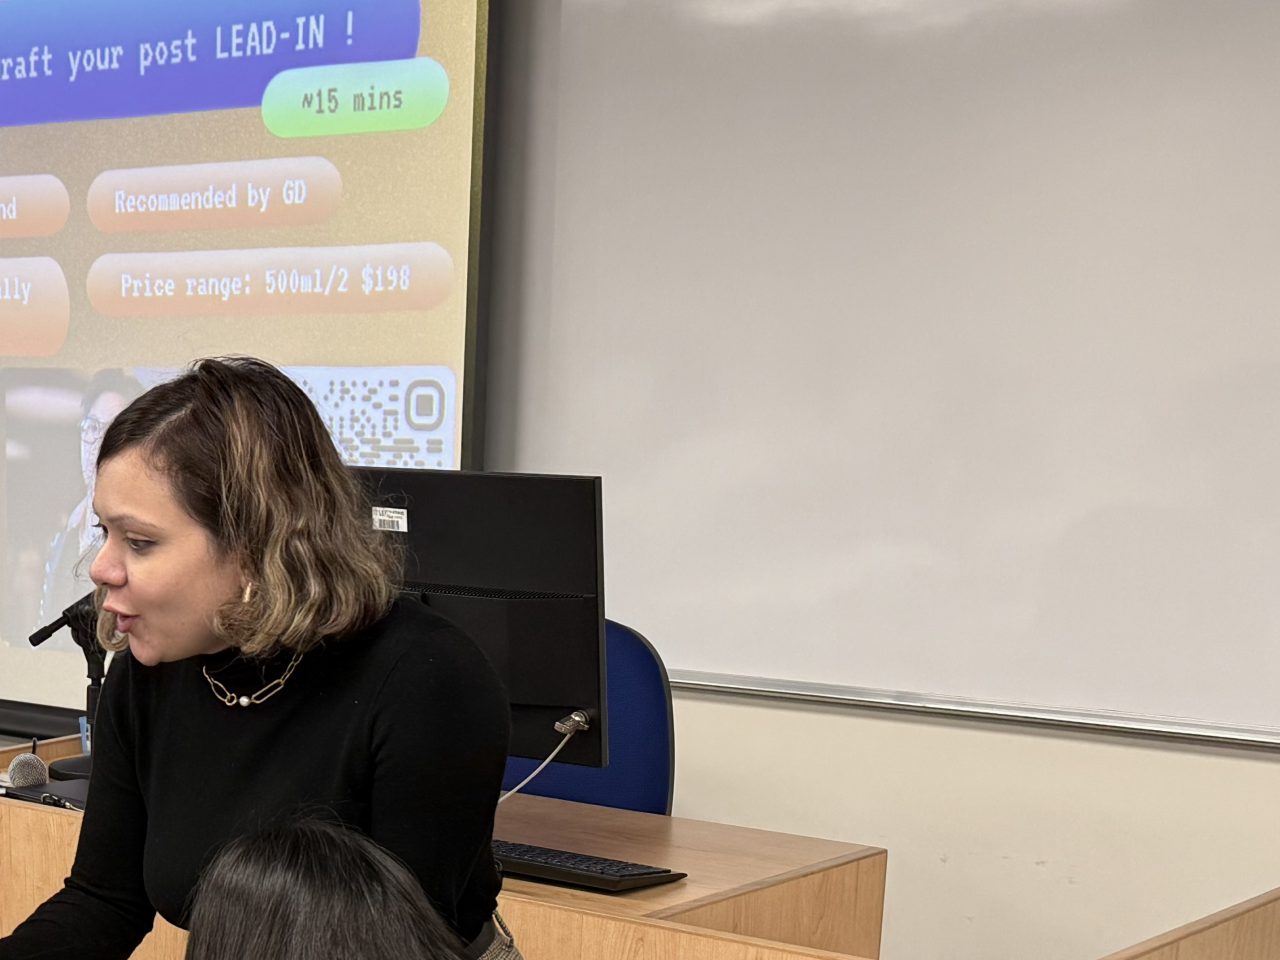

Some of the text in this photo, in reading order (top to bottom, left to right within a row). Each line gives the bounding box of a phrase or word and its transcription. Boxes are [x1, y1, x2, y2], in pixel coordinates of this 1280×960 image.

[68, 44, 123, 82] your
[139, 29, 197, 76] post
[216, 14, 325, 59] LEAD-IN
[353, 85, 403, 112] mins
[114, 179, 308, 214] Recommended by GD
[121, 263, 411, 301] Price range: 500ml/2 $198
